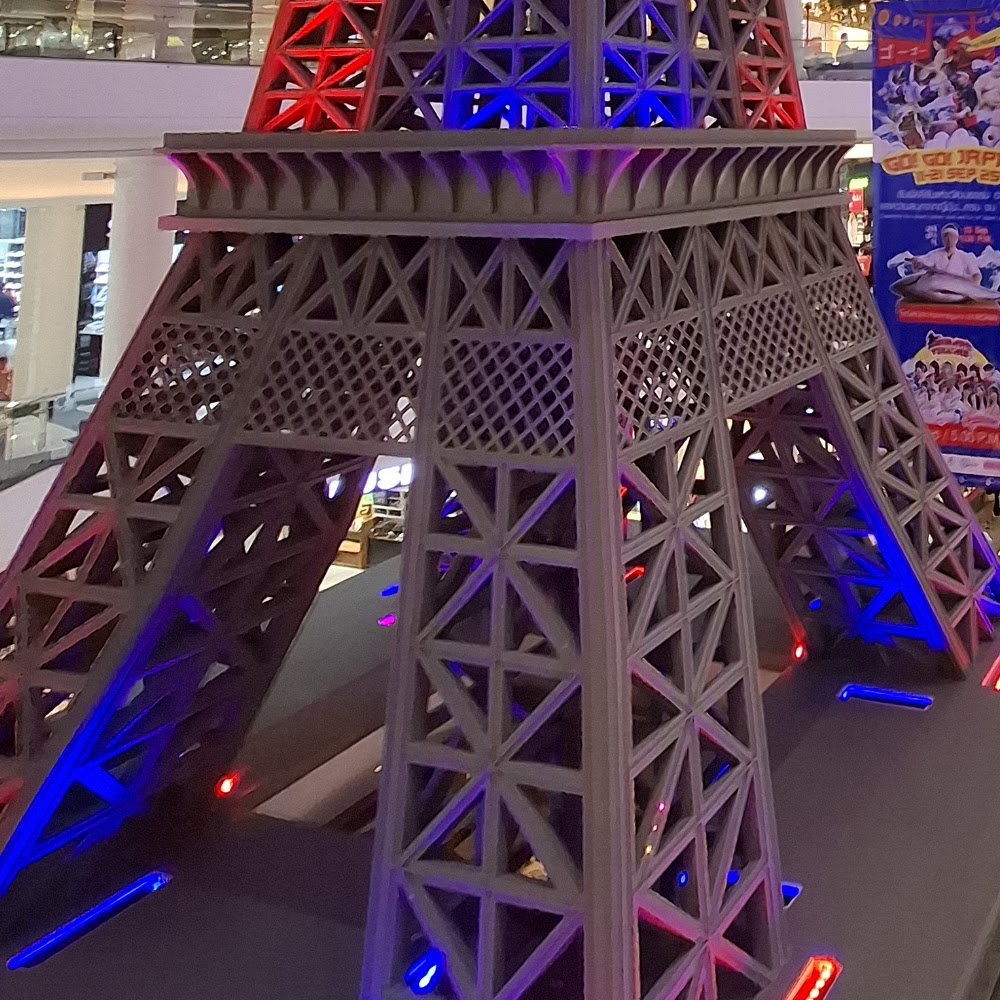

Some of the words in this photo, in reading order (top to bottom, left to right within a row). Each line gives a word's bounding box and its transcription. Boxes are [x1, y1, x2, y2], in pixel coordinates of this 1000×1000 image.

[884, 152, 917, 171] GO!
[922, 151, 952, 167] GO!
[947, 168, 976, 179] SEP
[980, 170, 1000, 182] 25
